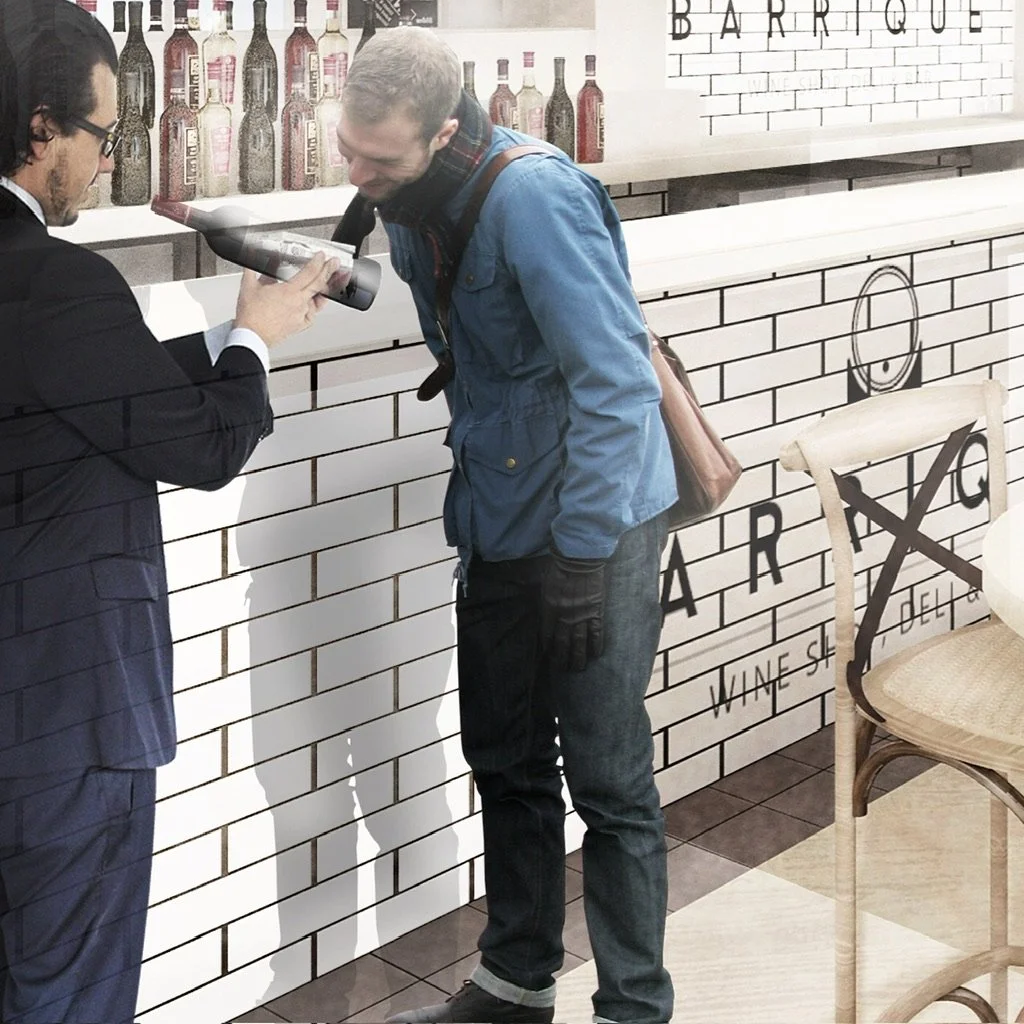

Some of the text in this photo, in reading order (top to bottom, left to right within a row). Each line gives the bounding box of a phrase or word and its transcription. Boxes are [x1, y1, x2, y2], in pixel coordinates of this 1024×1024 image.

[747, 77, 792, 98] WINE
[709, 652, 791, 720] WINE
[900, 581, 954, 635] DELI
